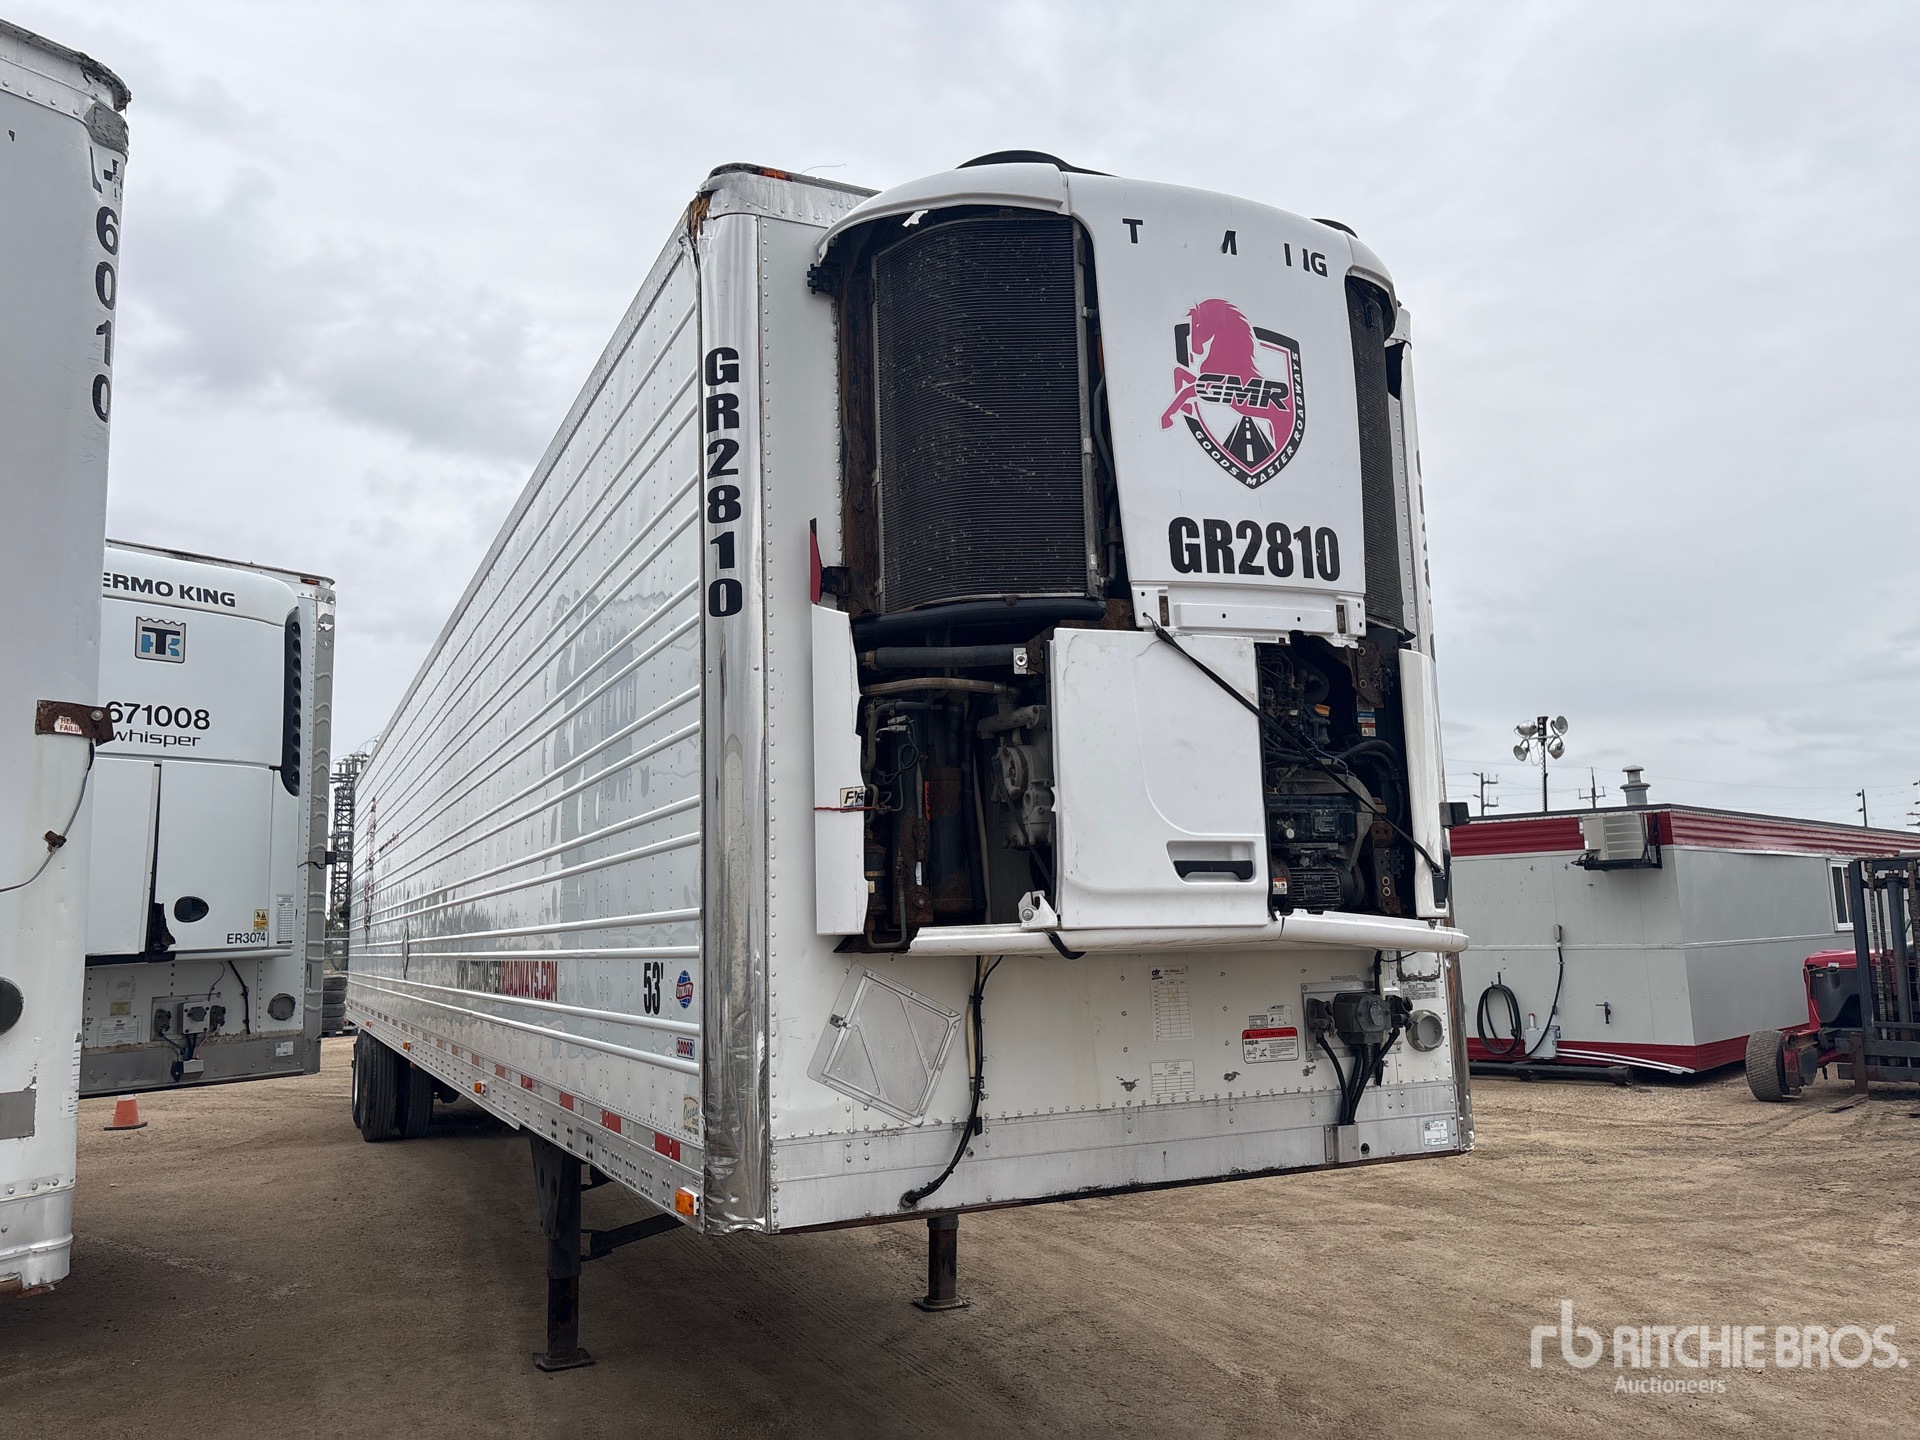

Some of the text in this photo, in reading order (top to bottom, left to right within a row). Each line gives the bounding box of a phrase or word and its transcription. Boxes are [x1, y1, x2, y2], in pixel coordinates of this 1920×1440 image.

[1195, 373, 1292, 412] GMR
[1195, 351, 1304, 487] GOODS MASTER ROADWAYS
[704, 346, 743, 618] GR2810
[1168, 516, 1341, 582] GR2810
[179, 584, 236, 608] KING
[113, 729, 201, 748] whisper
[226, 932, 266, 945] ER3074
